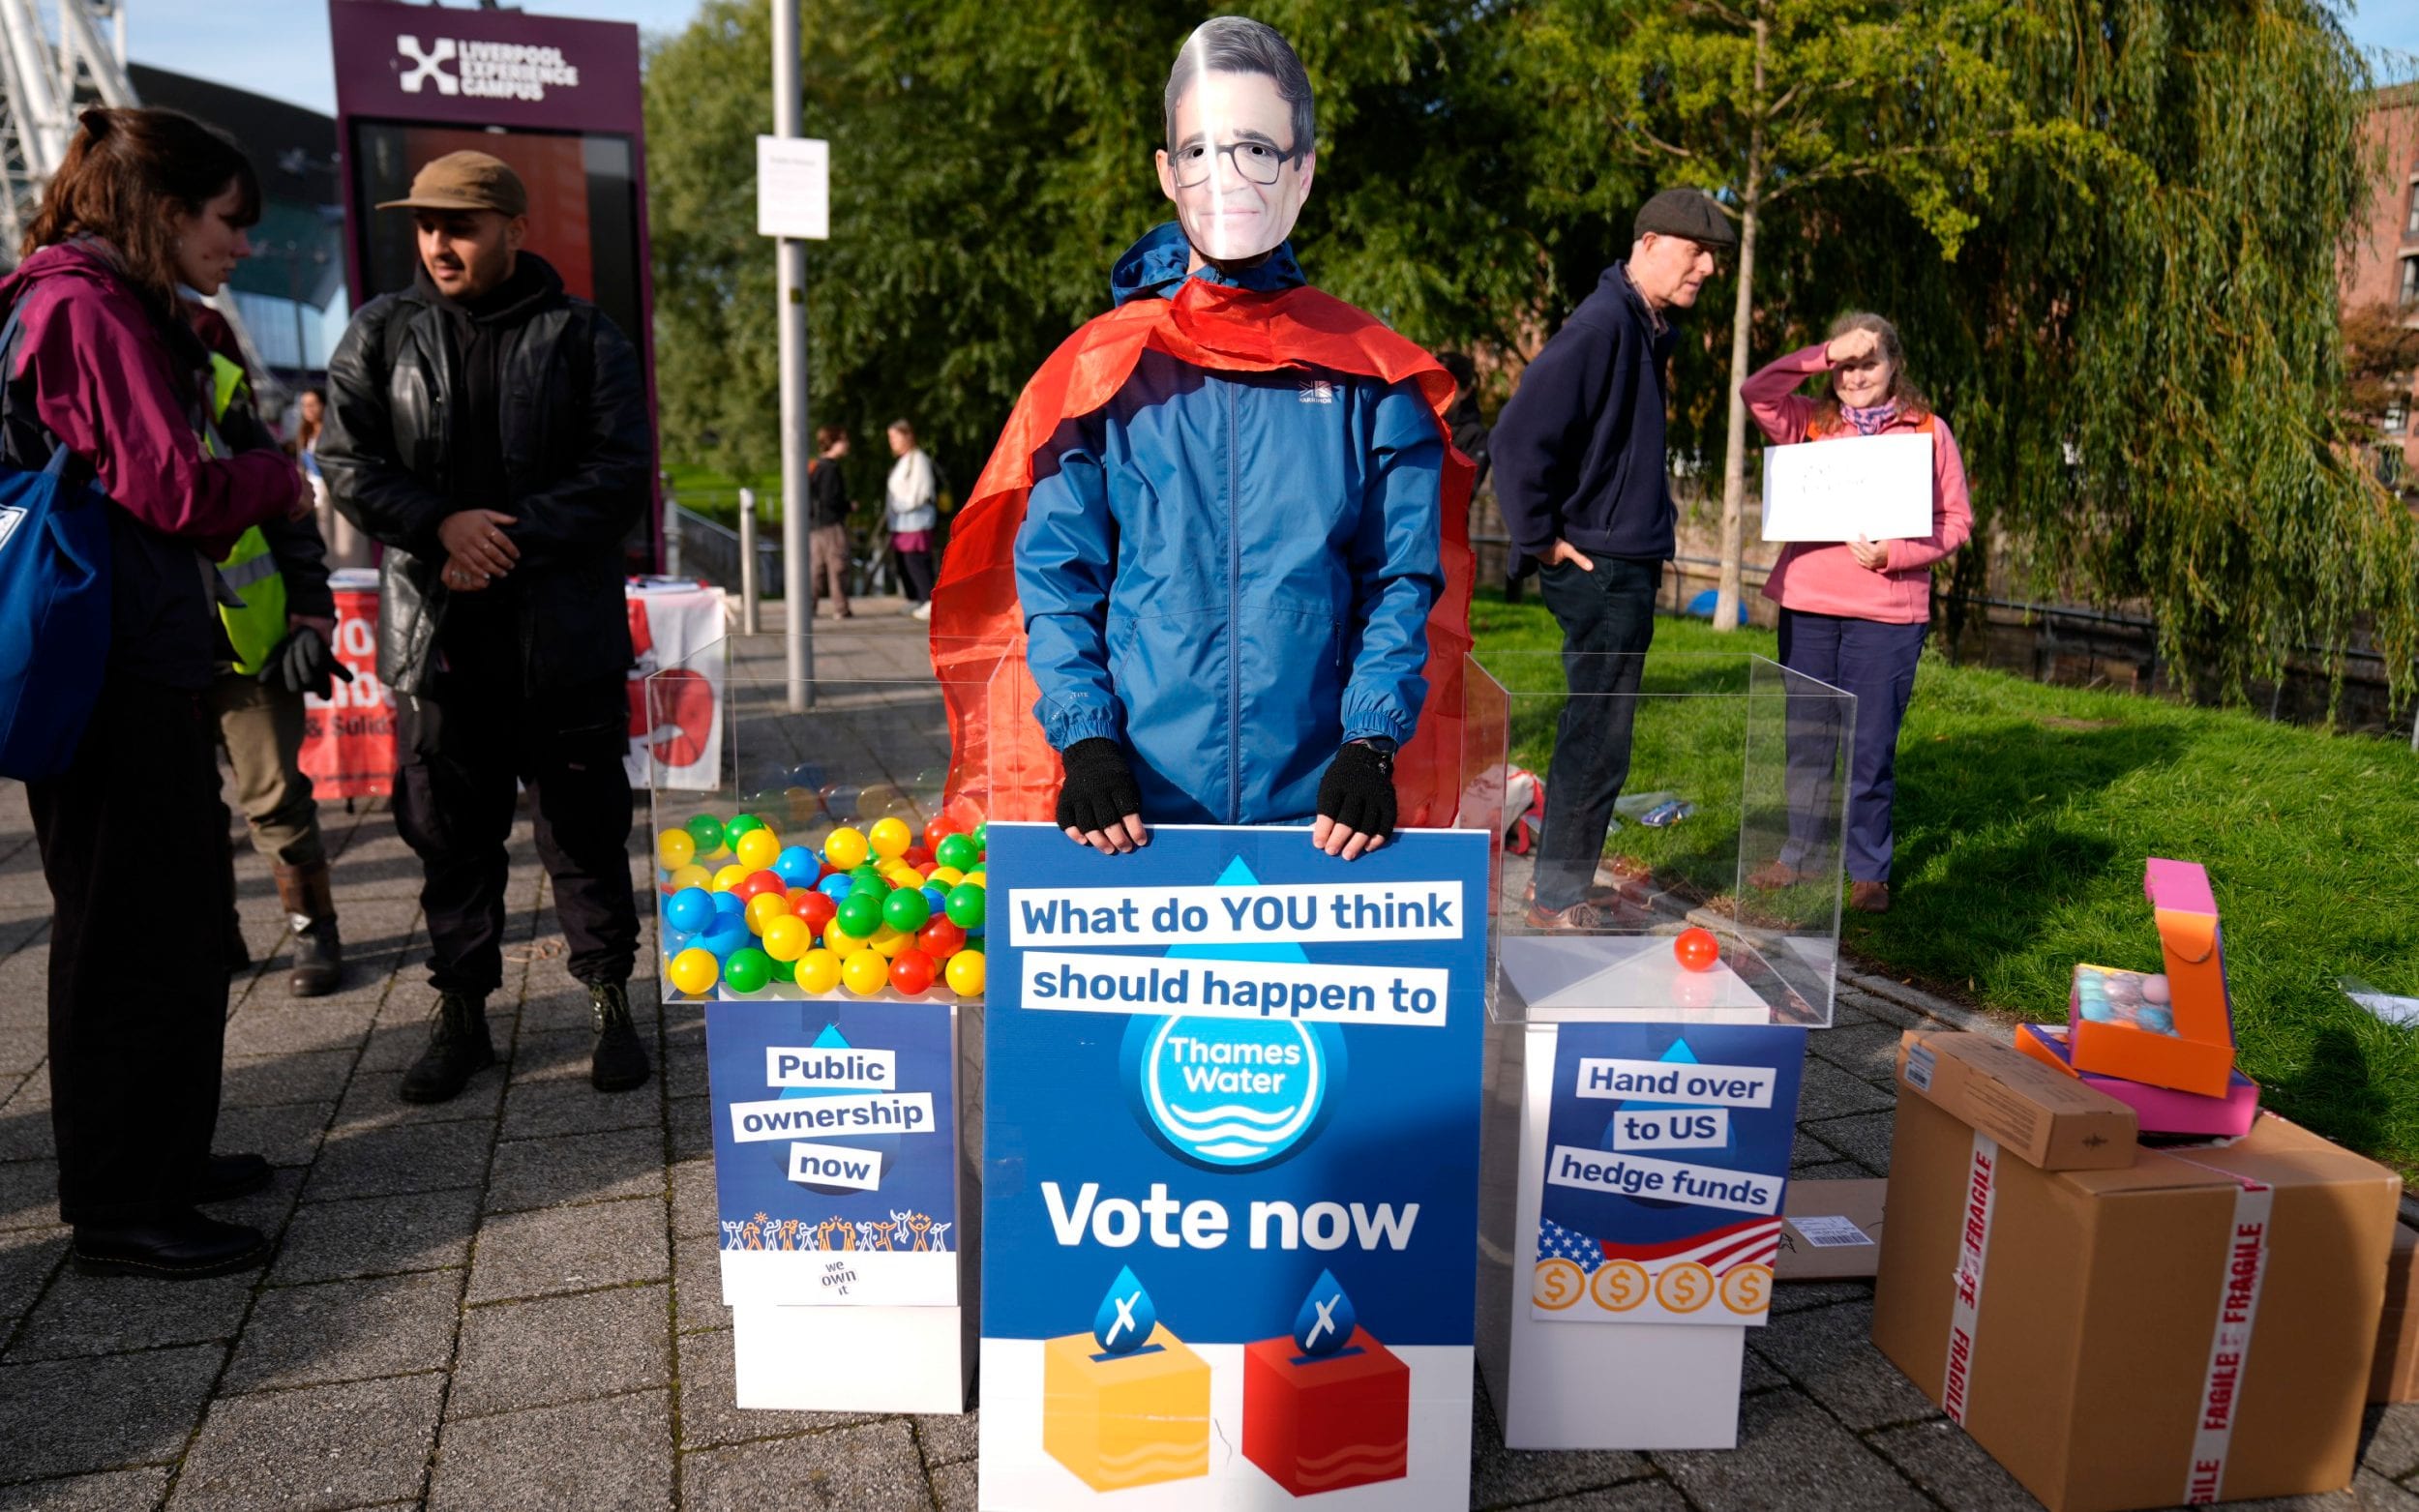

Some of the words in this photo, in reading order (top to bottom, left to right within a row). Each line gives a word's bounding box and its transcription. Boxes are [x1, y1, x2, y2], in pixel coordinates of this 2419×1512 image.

[459, 39, 568, 69] LIVERPOOL
[459, 58, 579, 86] EXPERIENCE
[461, 76, 545, 101] CAMPUS
[1021, 898, 1140, 935] What
[1151, 897, 1209, 934] do
[1221, 895, 1317, 933] YOU
[1330, 892, 1453, 929] think
[1032, 964, 1189, 1004] should
[1203, 970, 1375, 1018] happen
[1389, 978, 1437, 1015] to
[1168, 1037, 1300, 1065] Thames
[778, 1054, 885, 1082] Public
[1182, 1066, 1286, 1094] Water
[1589, 1066, 1679, 1095] Hand
[1687, 1077, 1764, 1099] over
[743, 1099, 923, 1133] ownership
[1625, 1117, 1659, 1141] to
[1670, 1115, 1717, 1139] US
[799, 1155, 871, 1180] now
[1560, 1154, 1663, 1193] hedge
[1672, 1170, 1769, 1205] funds
[1041, 1181, 1229, 1249] Vote
[1249, 1200, 1420, 1251] now
[1965, 1151, 1991, 1252] FRAGILE
[821, 1270, 856, 1287] own
[825, 1260, 845, 1272] we
[2224, 1222, 2263, 1323] FRAGILE
[838, 1285, 850, 1296] it
[1945, 1326, 1970, 1426] FRAGILE
